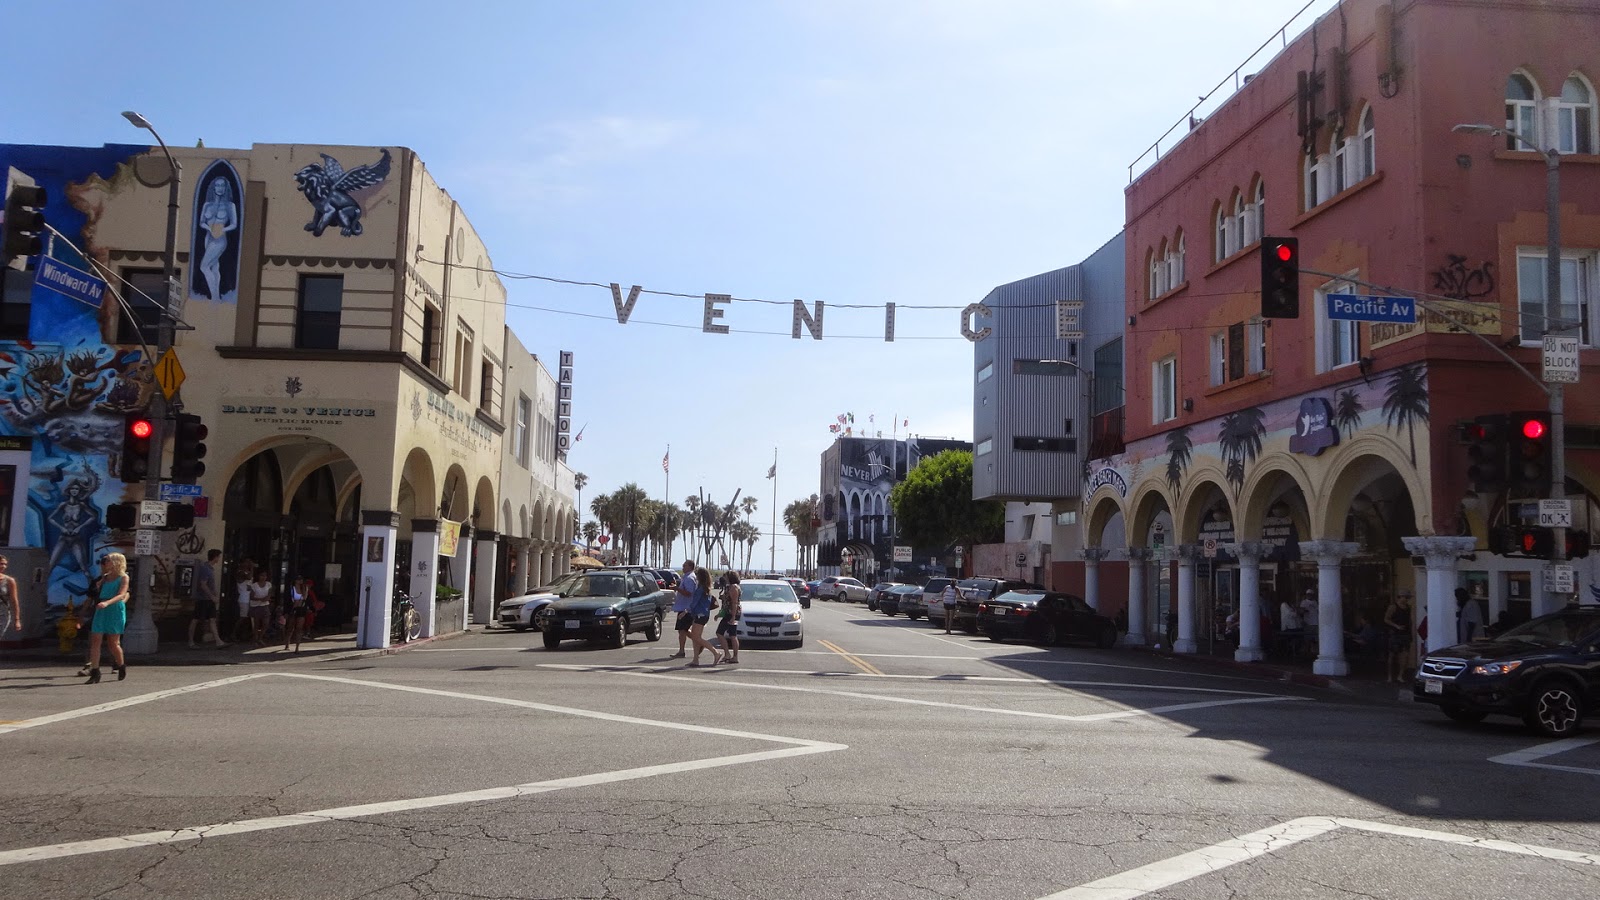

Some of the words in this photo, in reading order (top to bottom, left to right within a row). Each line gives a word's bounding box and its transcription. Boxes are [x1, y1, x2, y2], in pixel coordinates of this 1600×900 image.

[43, 263, 89, 294] Windward
[88, 283, 102, 299] Av
[610, 282, 1085, 342] VENICE
[1334, 299, 1387, 315] Pacific
[1390, 302, 1410, 316] Av
[1544, 342, 1556, 353] DO
[1560, 342, 1577, 353] NOT
[1544, 356, 1577, 368] BLOCK
[427, 388, 456, 420] BANK
[559, 353, 571, 447] TATTOO
[222, 404, 277, 414] BANK
[303, 407, 376, 417] VENICE
[1098, 469, 1112, 484] BEACH
[164, 484, 188, 494] Pacific
[141, 513, 152, 523] OK
[1541, 513, 1553, 524] OK
